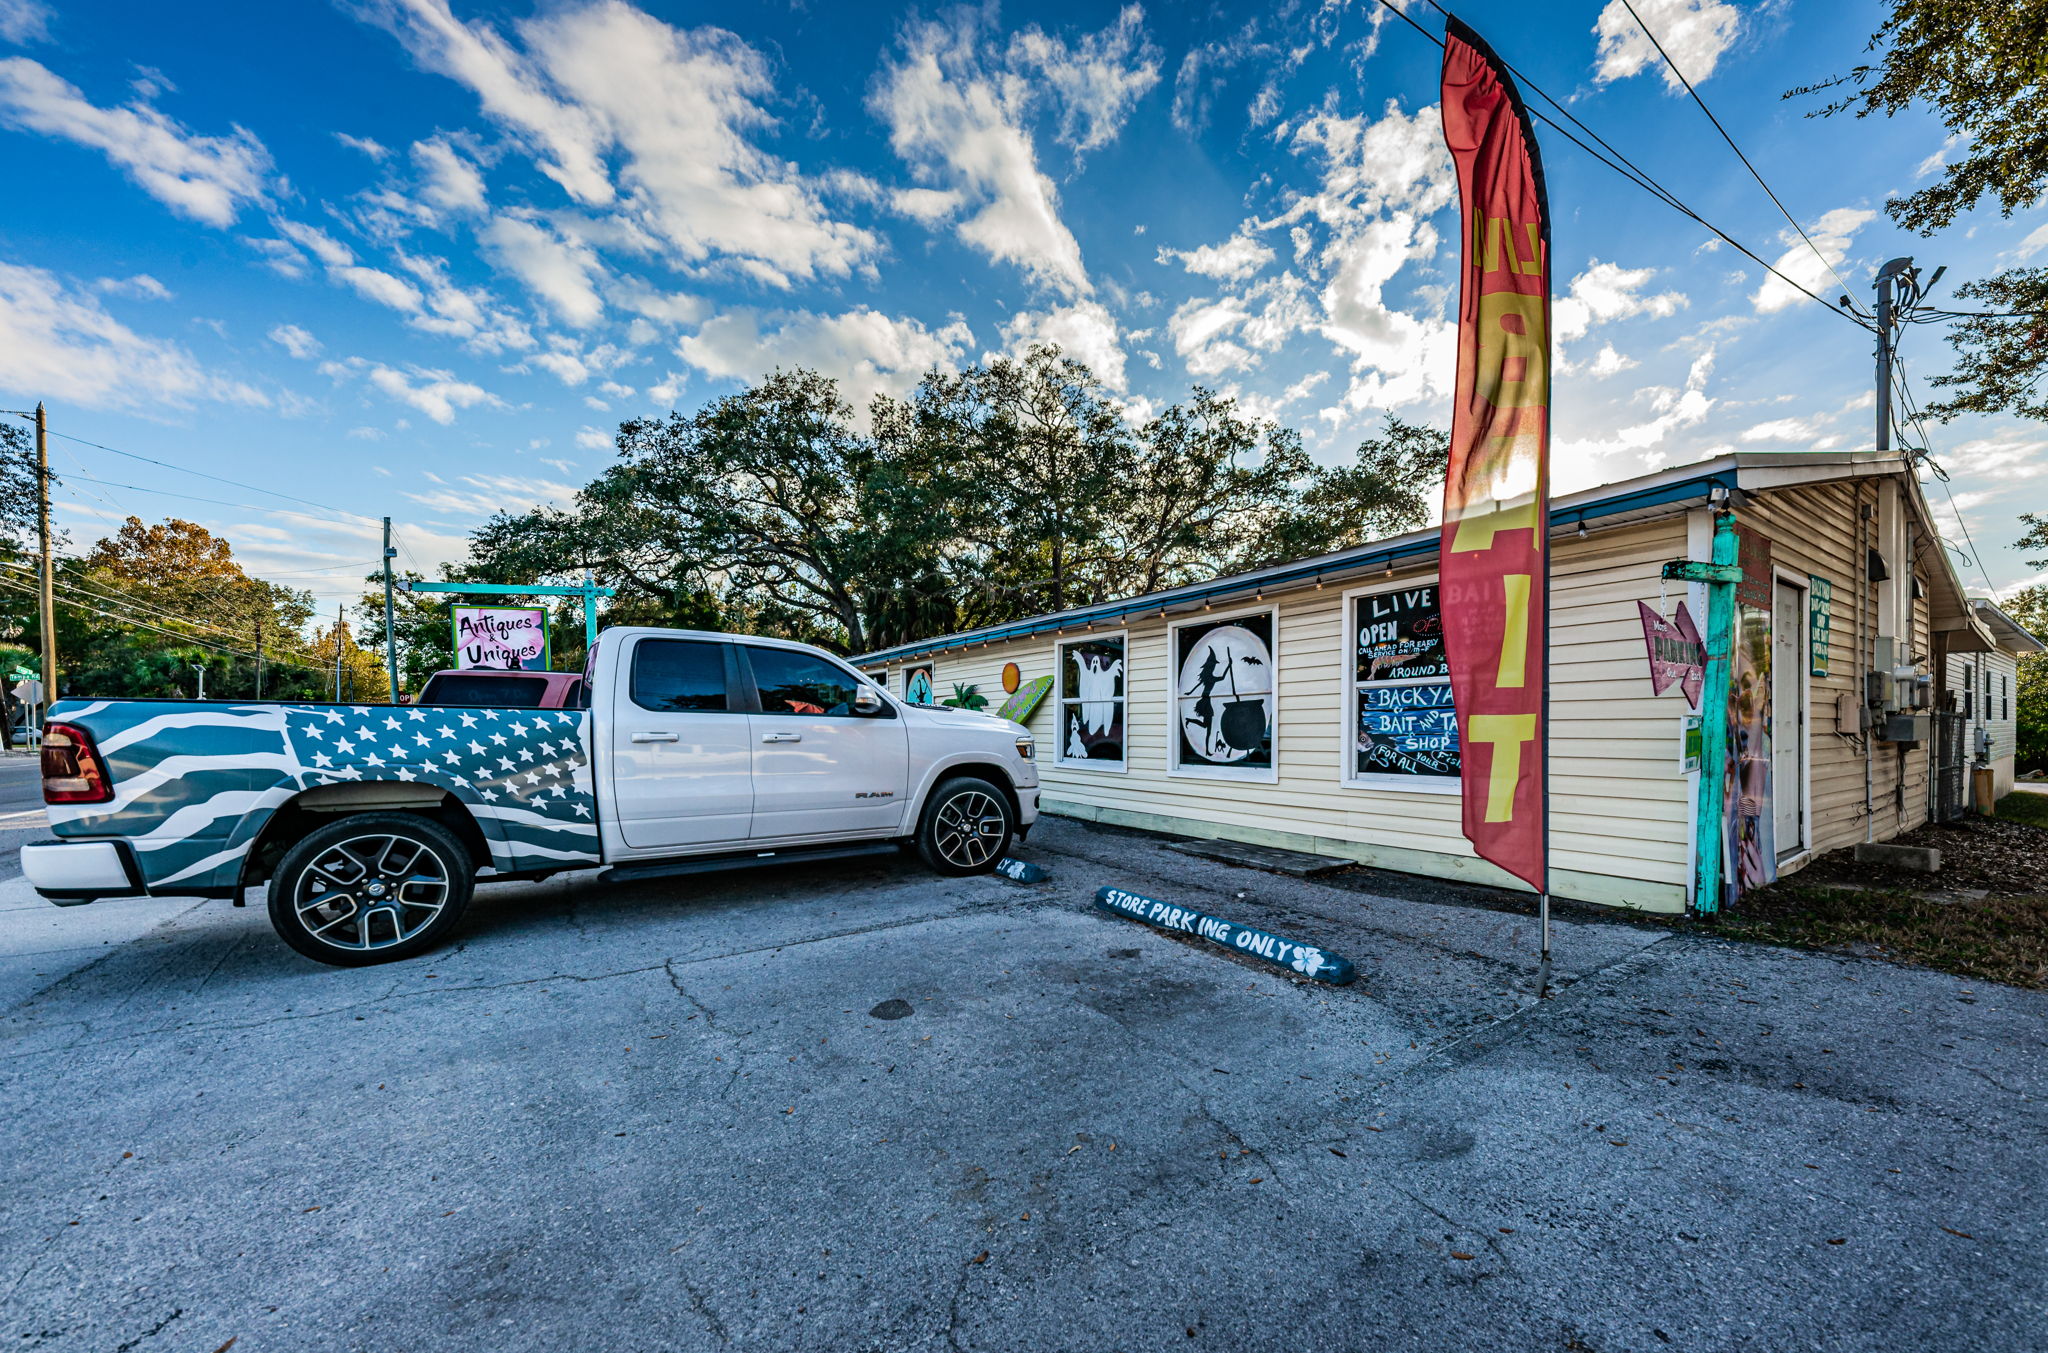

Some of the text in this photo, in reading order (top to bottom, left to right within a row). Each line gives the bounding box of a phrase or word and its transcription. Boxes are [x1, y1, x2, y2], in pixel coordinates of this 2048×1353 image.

[1372, 588, 1432, 618] LIVE
[459, 615, 533, 641] Antiques
[489, 634, 497, 642] &
[1359, 620, 1398, 647] OPEN
[1358, 638, 1439, 655] CALL AHEAD FOR EARLY
[1368, 649, 1396, 659] SERVICE
[1654, 635, 1703, 668] PARKING
[466, 645, 537, 669] Uniques
[1389, 665, 1436, 678] AROUND
[399, 694, 410, 702] OP
[1379, 715, 1418, 734] BAIT
[1419, 710, 1439, 731] AND
[1405, 735, 1451, 751] SHOP
[1377, 745, 1397, 763] FOR
[1397, 756, 1418, 774] ALL
[855, 791, 894, 799] RAM
[996, 858, 1011, 871] LY
[1105, 889, 1151, 916] STORE
[1235, 930, 1293, 961] ONLY
